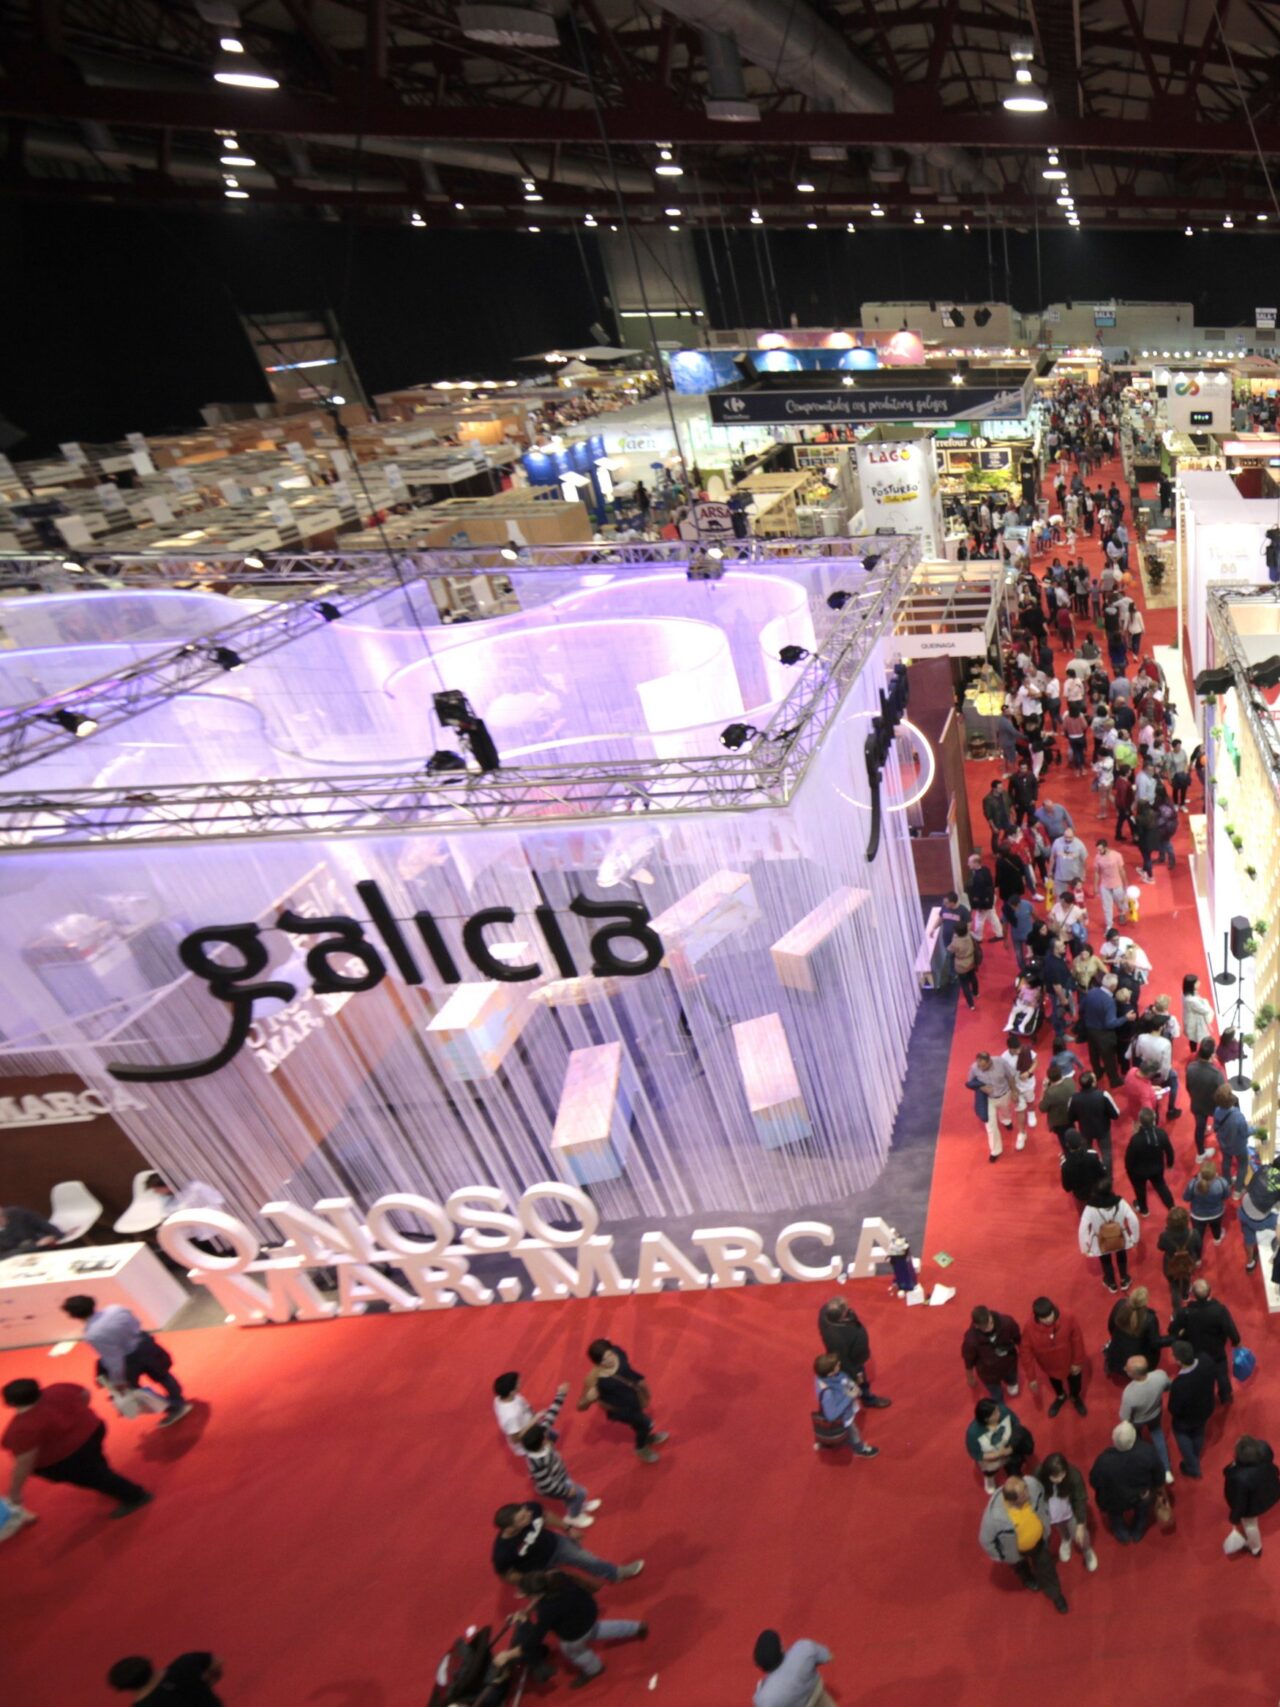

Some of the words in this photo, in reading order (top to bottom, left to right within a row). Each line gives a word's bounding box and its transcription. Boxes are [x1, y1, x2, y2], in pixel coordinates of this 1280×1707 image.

[936, 438, 968, 448] rrefour
[106, 879, 665, 1083] galicia
[259, 1180, 598, 1264] NOSO
[511, 1216, 921, 1302] MARCA
